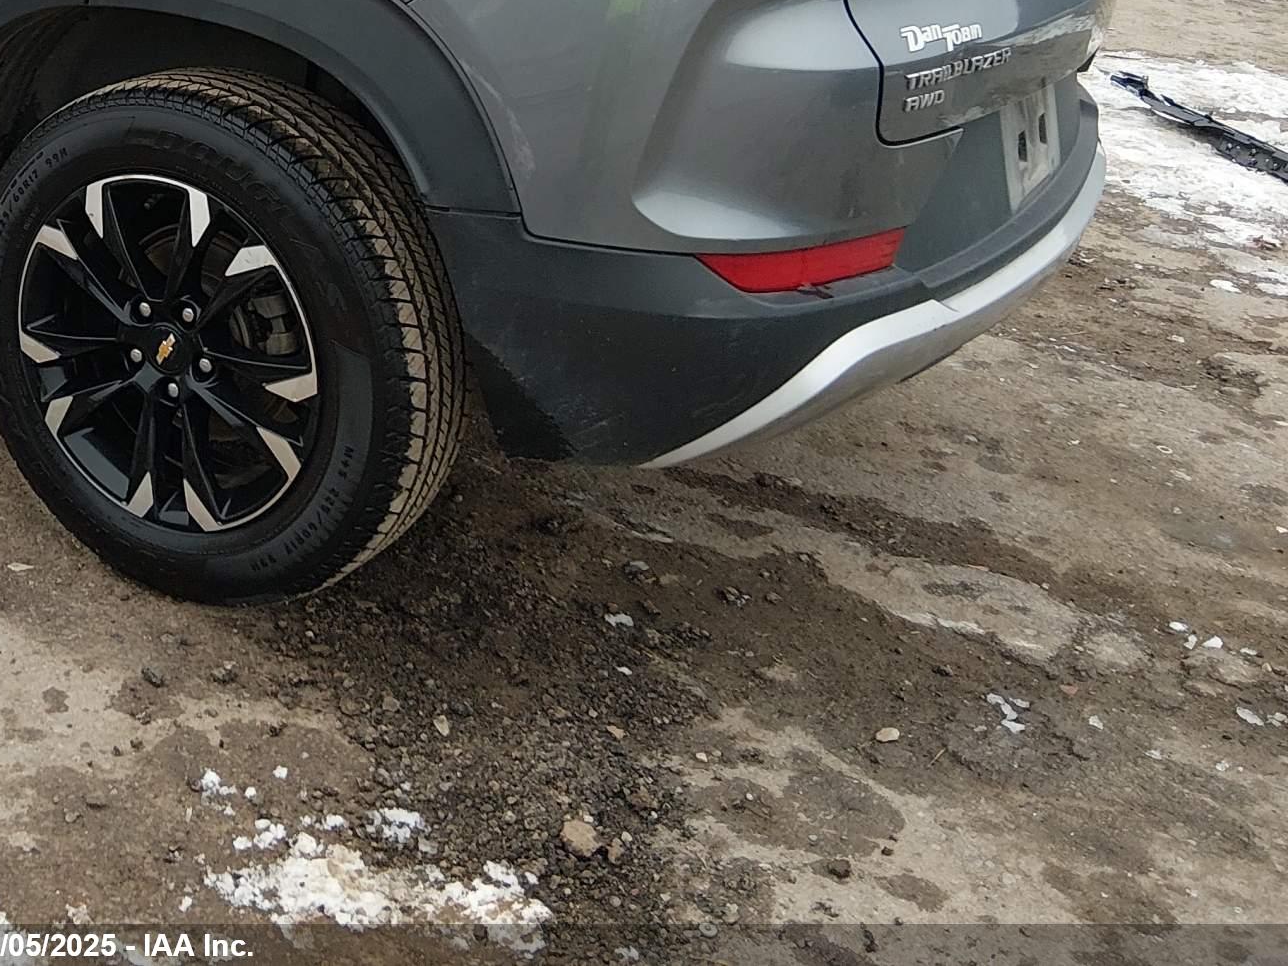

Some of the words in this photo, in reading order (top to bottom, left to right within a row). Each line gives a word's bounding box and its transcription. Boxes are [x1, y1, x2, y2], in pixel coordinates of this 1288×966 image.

[900, 23, 943, 52] Dan
[904, 47, 1012, 90] TRAILBLAZER
[903, 89, 945, 113] AWD
